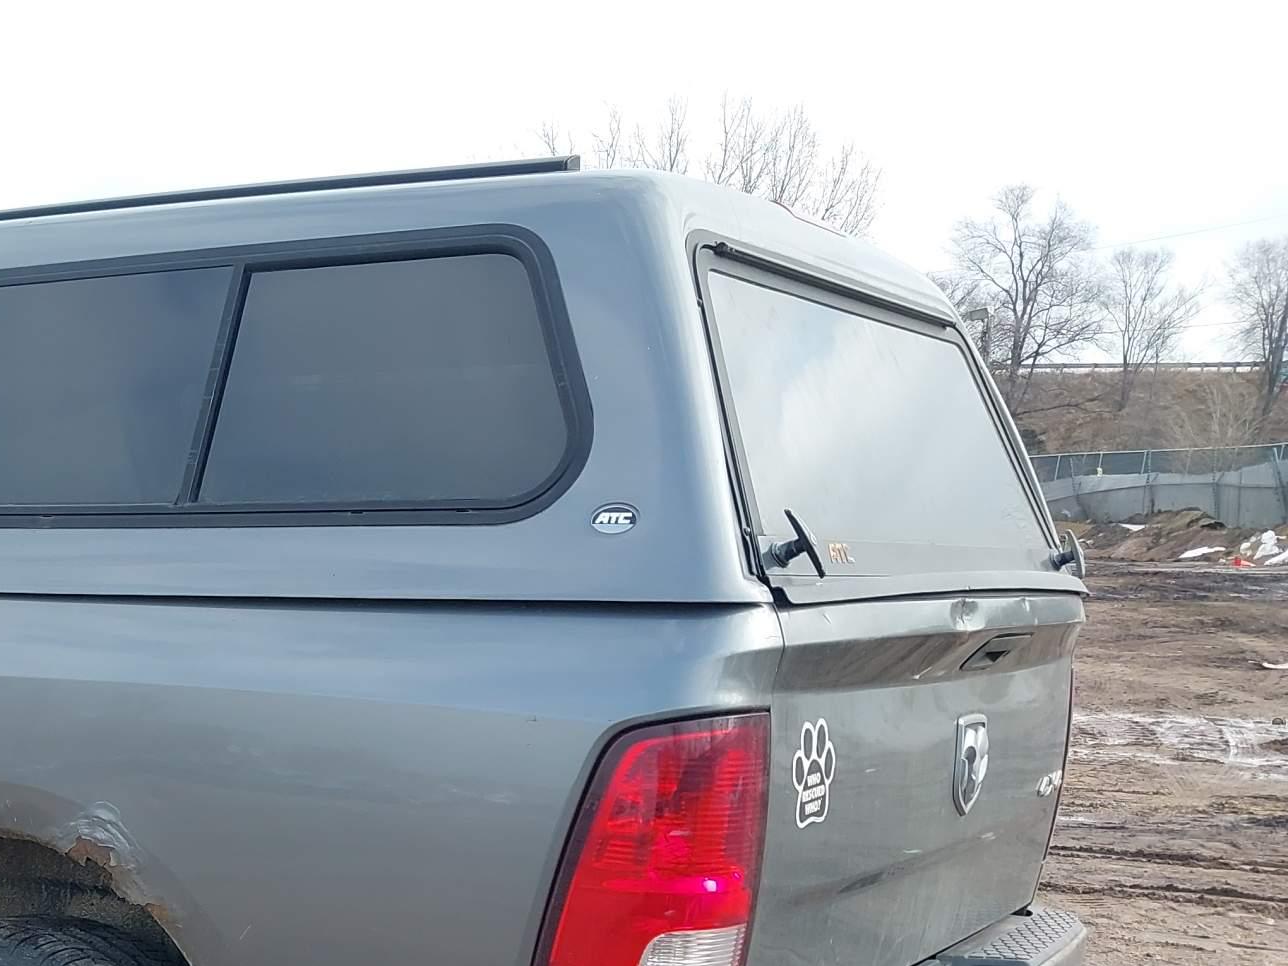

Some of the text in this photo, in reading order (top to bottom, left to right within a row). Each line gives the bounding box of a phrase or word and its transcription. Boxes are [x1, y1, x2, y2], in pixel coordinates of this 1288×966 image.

[595, 512, 633, 524] ATC
[806, 772, 822, 787] WHO
[802, 784, 825, 803] RESCUED
